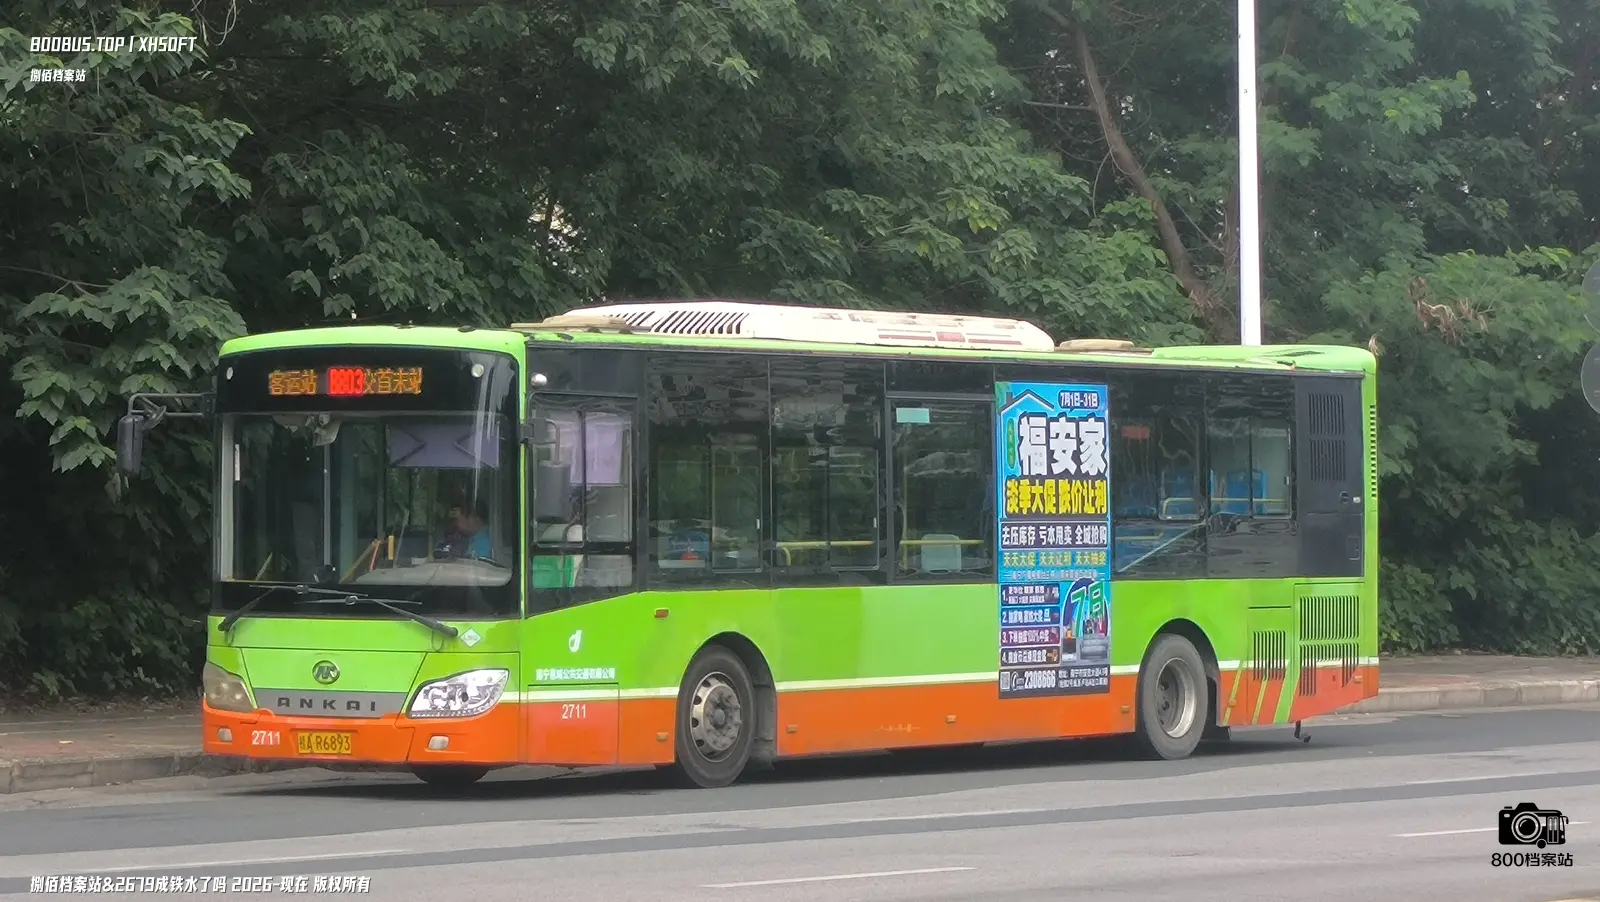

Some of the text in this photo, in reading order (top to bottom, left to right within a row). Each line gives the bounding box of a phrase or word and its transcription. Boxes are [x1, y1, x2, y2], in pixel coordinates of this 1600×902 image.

[1018, 415, 1107, 476] 福安家
[1038, 525, 1073, 546] 亏本甩卖
[276, 696, 377, 712] ANKAI
[562, 703, 587, 720] 2711
[251, 729, 281, 746] 2711
